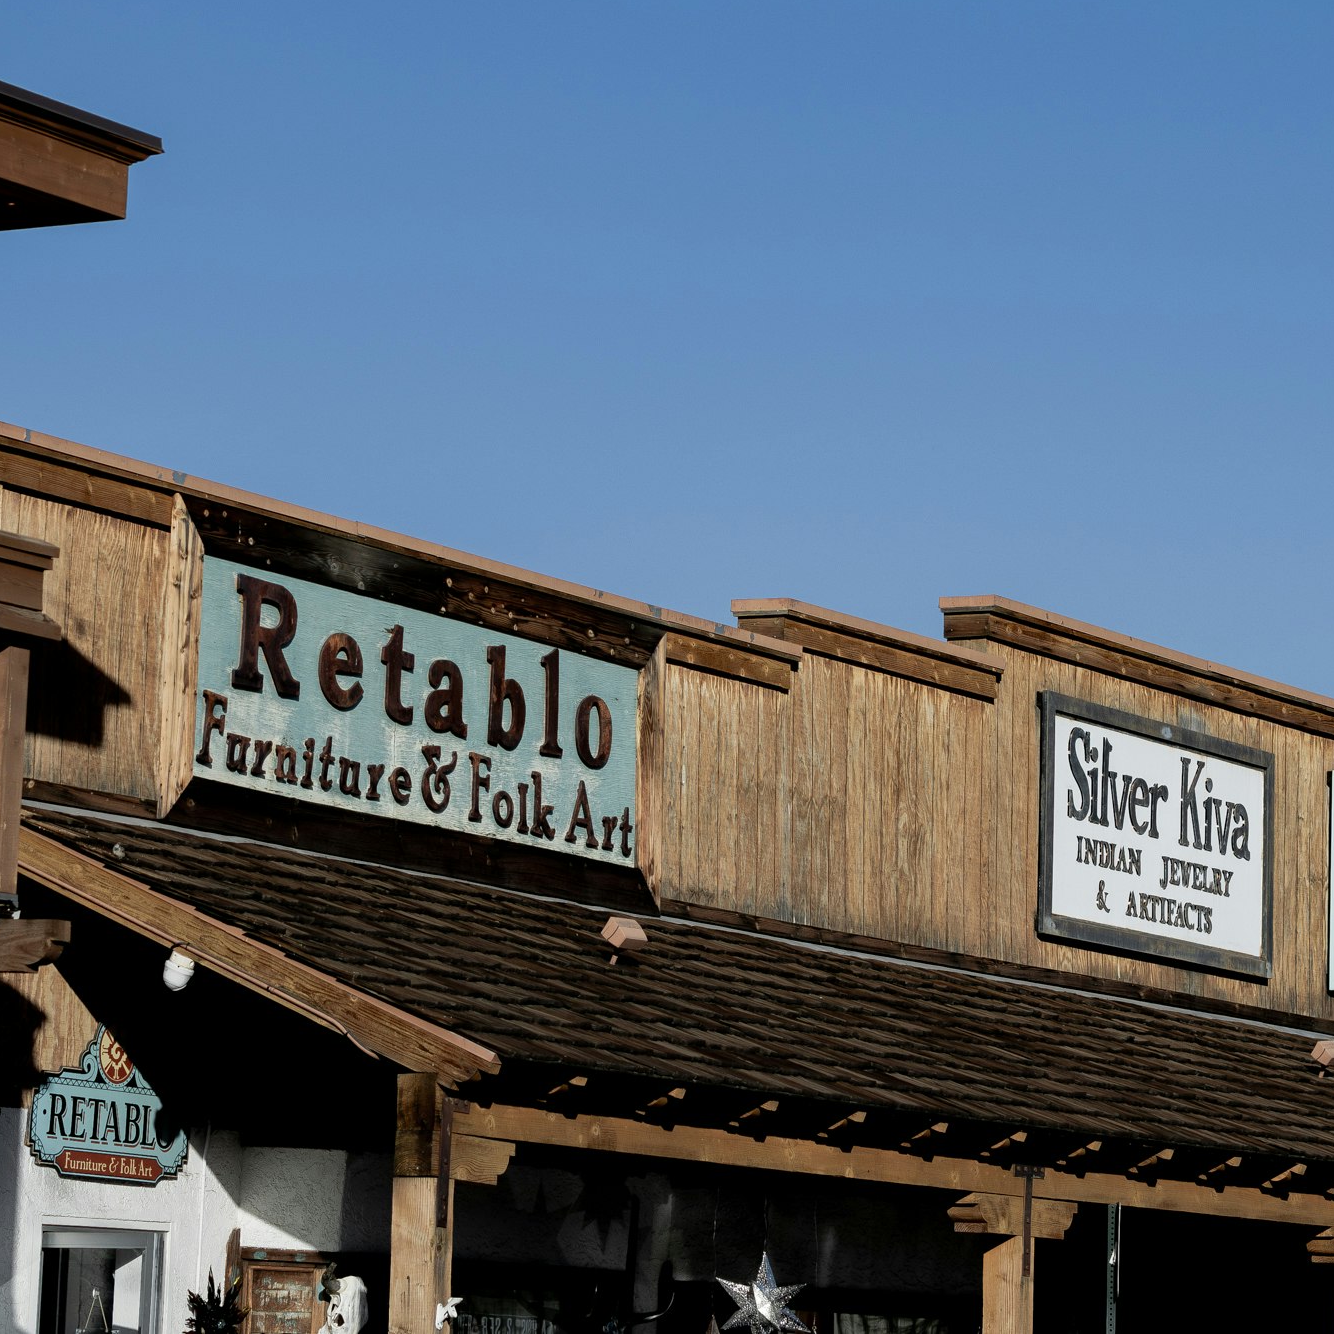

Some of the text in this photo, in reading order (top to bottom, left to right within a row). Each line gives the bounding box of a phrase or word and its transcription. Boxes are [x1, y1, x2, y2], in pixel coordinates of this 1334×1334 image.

[231, 573, 613, 770] Retablo
[195, 689, 634, 858] Furniture & Folk Art
[1067, 726, 1251, 862] Silver Kiva
[1075, 835, 1234, 898] INDIAN JEWELRY
[1096, 879, 1213, 935] & ARTIFACTS
[64, 1152, 152, 1177] Furniture & Folk Art
